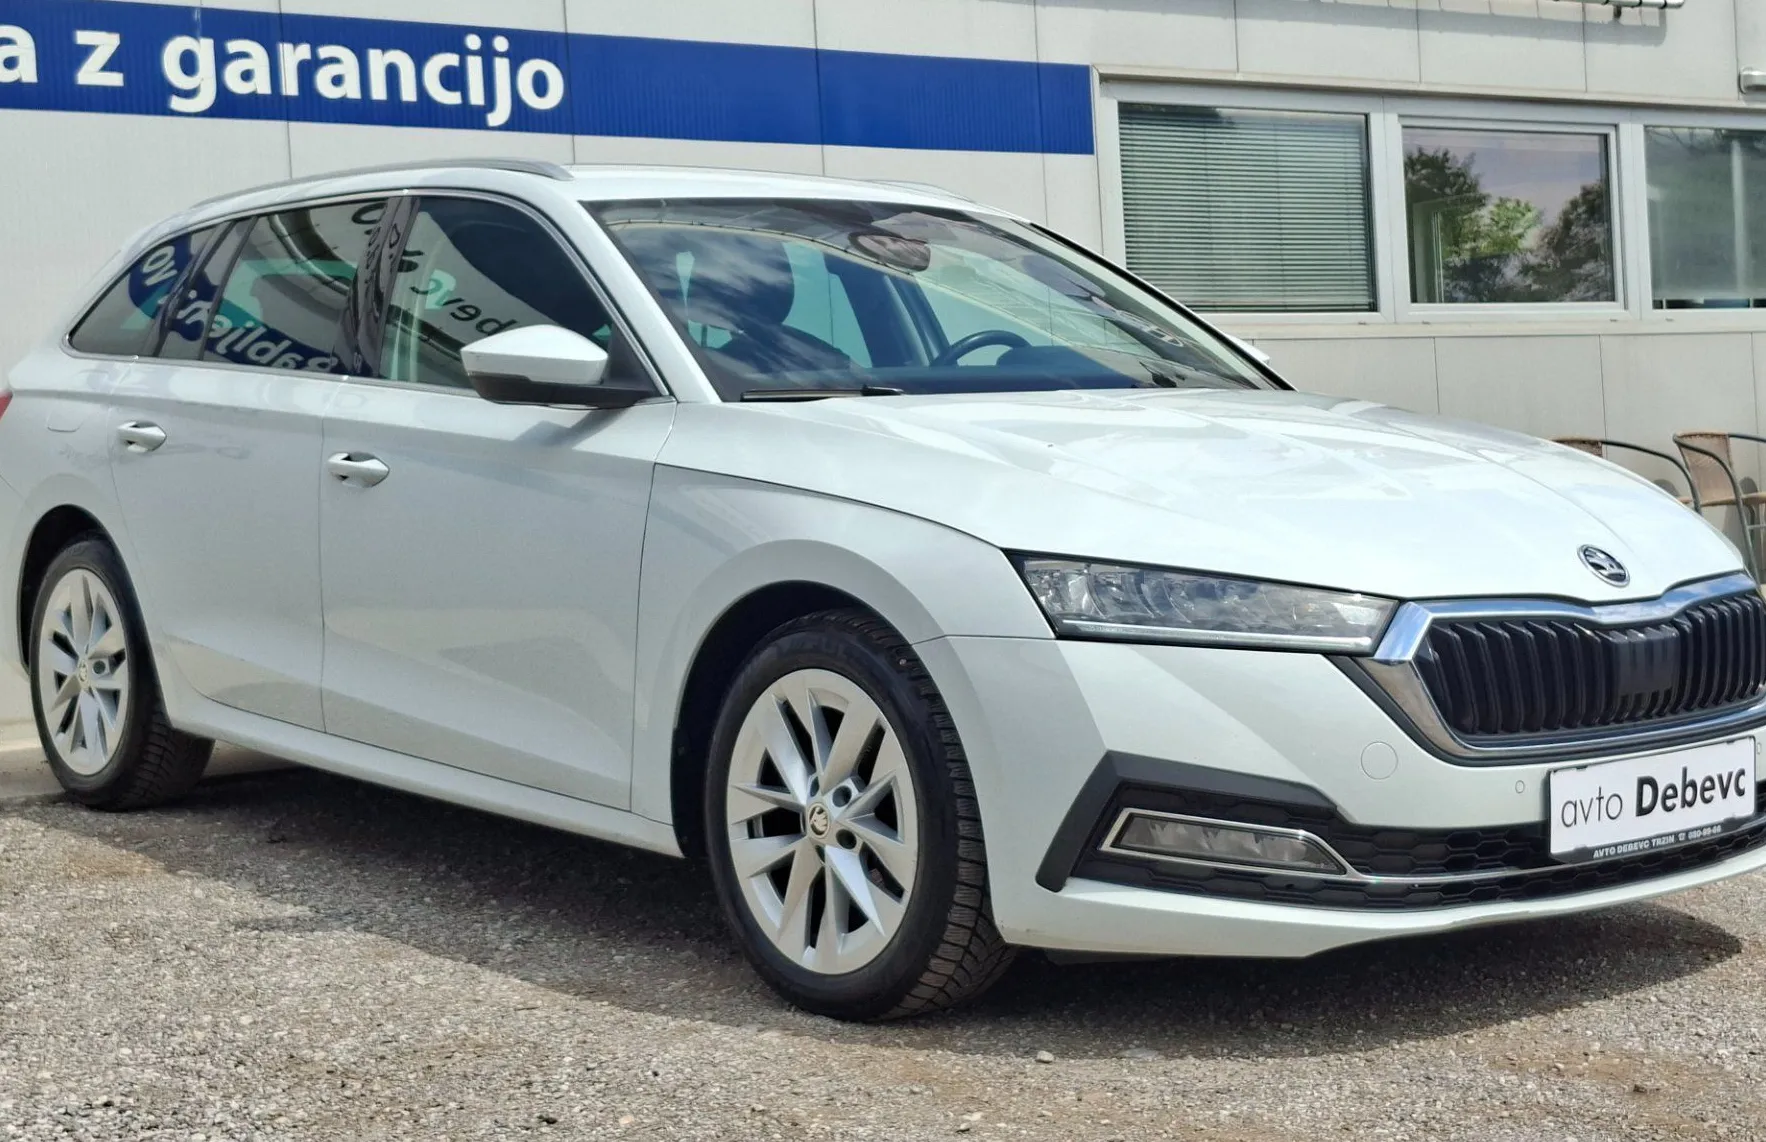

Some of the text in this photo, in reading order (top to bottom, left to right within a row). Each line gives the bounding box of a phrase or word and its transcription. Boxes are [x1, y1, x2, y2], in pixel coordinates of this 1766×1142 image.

[75, 30, 124, 88] z
[162, 34, 565, 127] garancijo
[1561, 766, 1746, 828] avto Debevc
[1593, 846, 1616, 858] AVTO
[1617, 839, 1650, 854] DEBEVC
[1651, 834, 1675, 848] TRZIN
